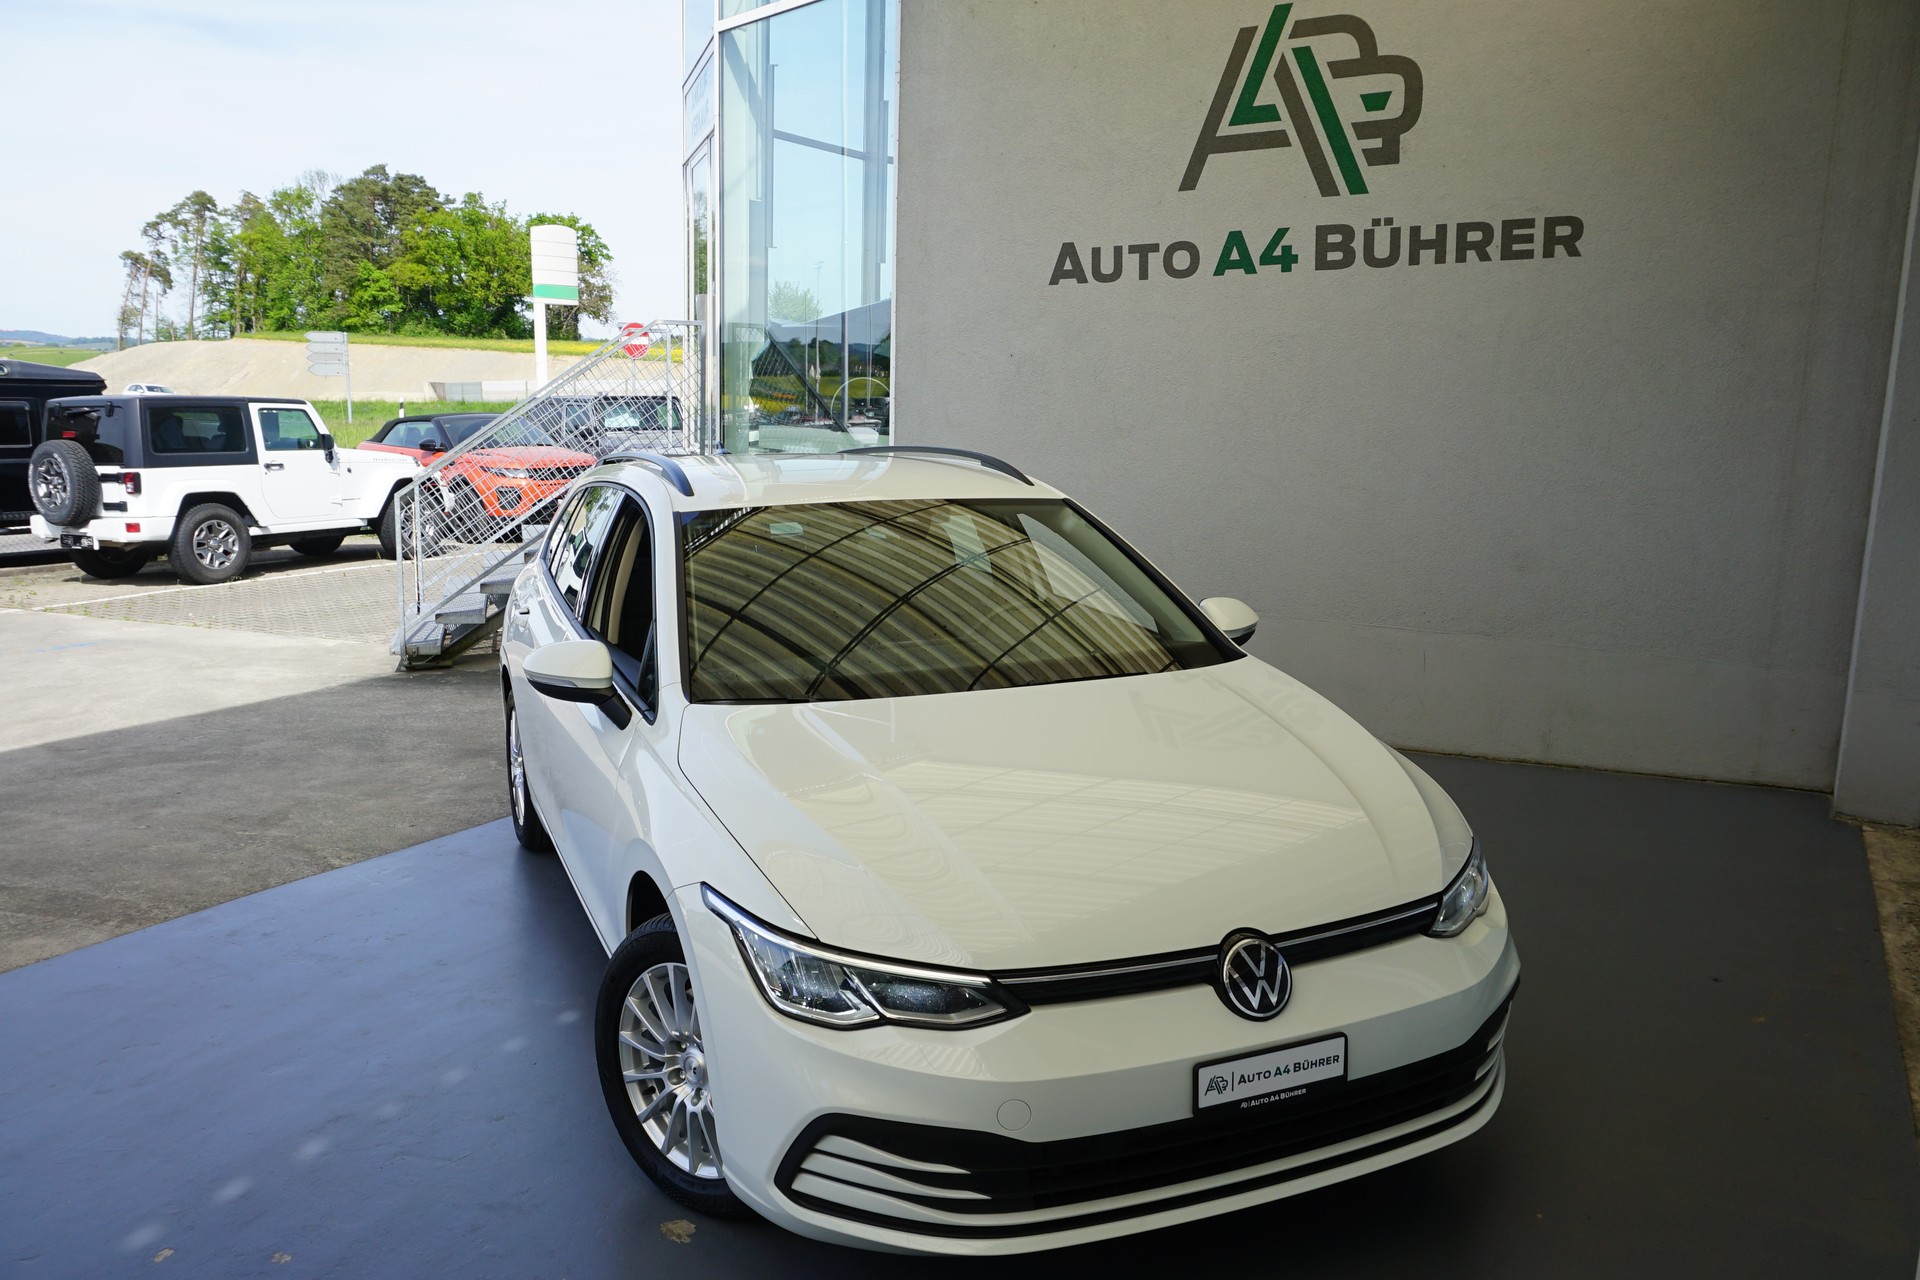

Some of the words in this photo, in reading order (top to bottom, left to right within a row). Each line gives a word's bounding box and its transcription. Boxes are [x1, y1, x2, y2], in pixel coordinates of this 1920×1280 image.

[1048, 240, 1200, 286] AUTO
[1212, 227, 1299, 277] A4
[1314, 215, 1585, 272] BÜHRER
[1237, 1069, 1272, 1086] AUTO
[1273, 1064, 1291, 1078] A4
[1293, 1054, 1340, 1074] BÜHRER
[1250, 1097, 1270, 1107] AUTO
[1270, 1093, 1280, 1102] A4
